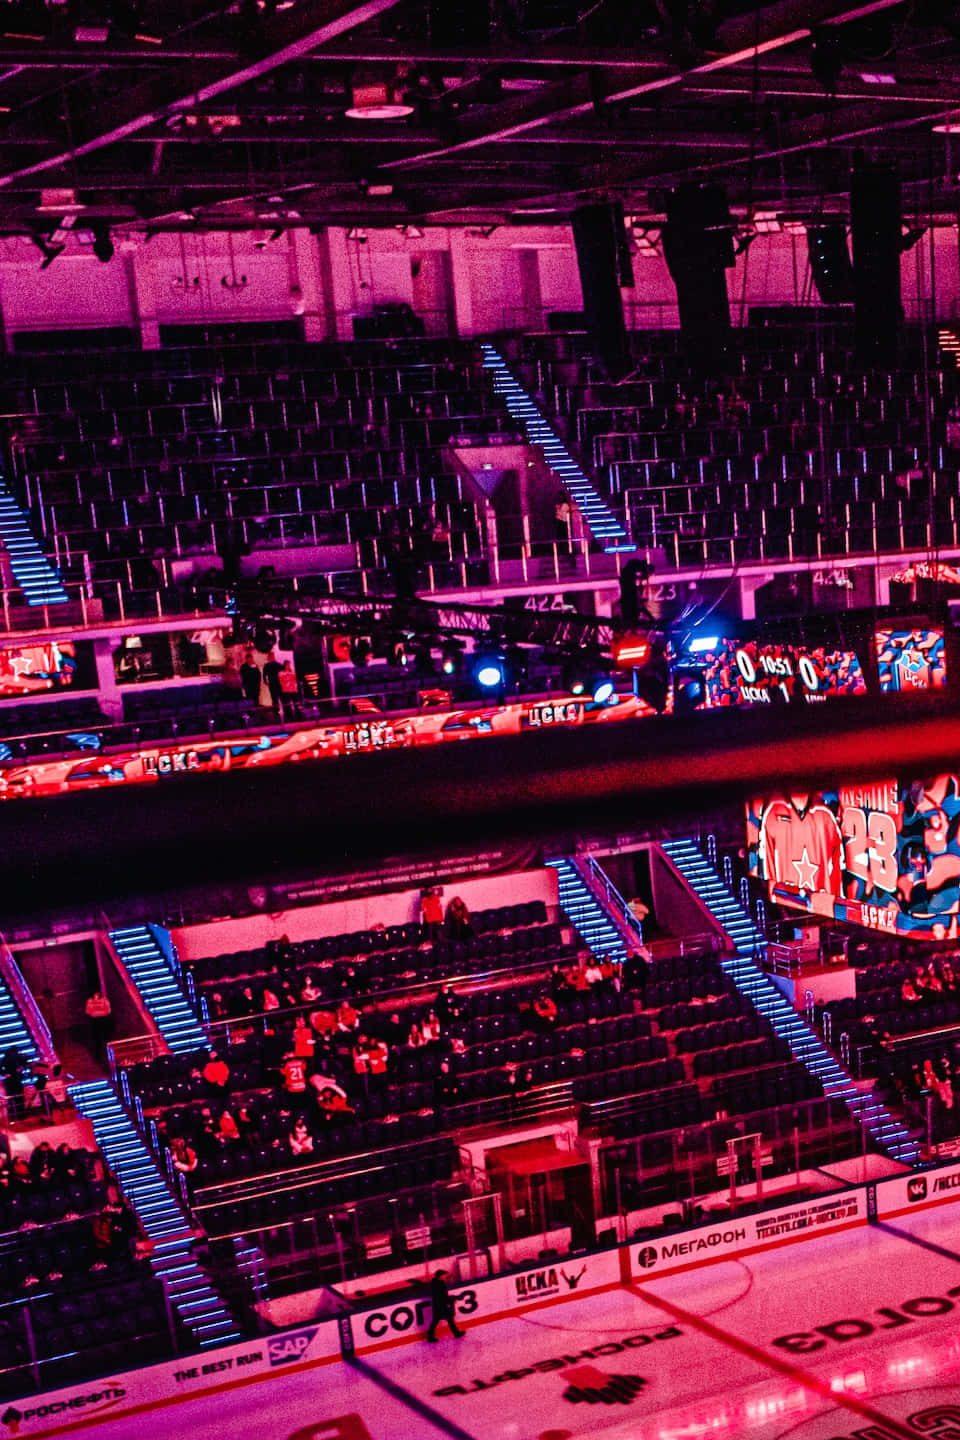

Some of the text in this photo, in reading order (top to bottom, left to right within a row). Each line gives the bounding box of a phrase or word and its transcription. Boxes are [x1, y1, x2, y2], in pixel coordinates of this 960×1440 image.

[736, 650, 818, 690] 0 10:51 0
[740, 686, 771, 703] ЦСКА
[529, 703, 577, 728] ЦСКА
[344, 725, 396, 750] ЦСКА
[142, 752, 200, 777] ЦСКА
[843, 807, 898, 893] 23
[860, 904, 897, 929] ЦСКА
[515, 1268, 559, 1295] ЦСКА
[364, 1289, 479, 1338] согз
[173, 1334, 309, 1383] THE BEST RUN SAP
[433, 1326, 684, 1397] РОСНЕФТЬ
[23, 1386, 126, 1421] РОСНЕФТЬ
